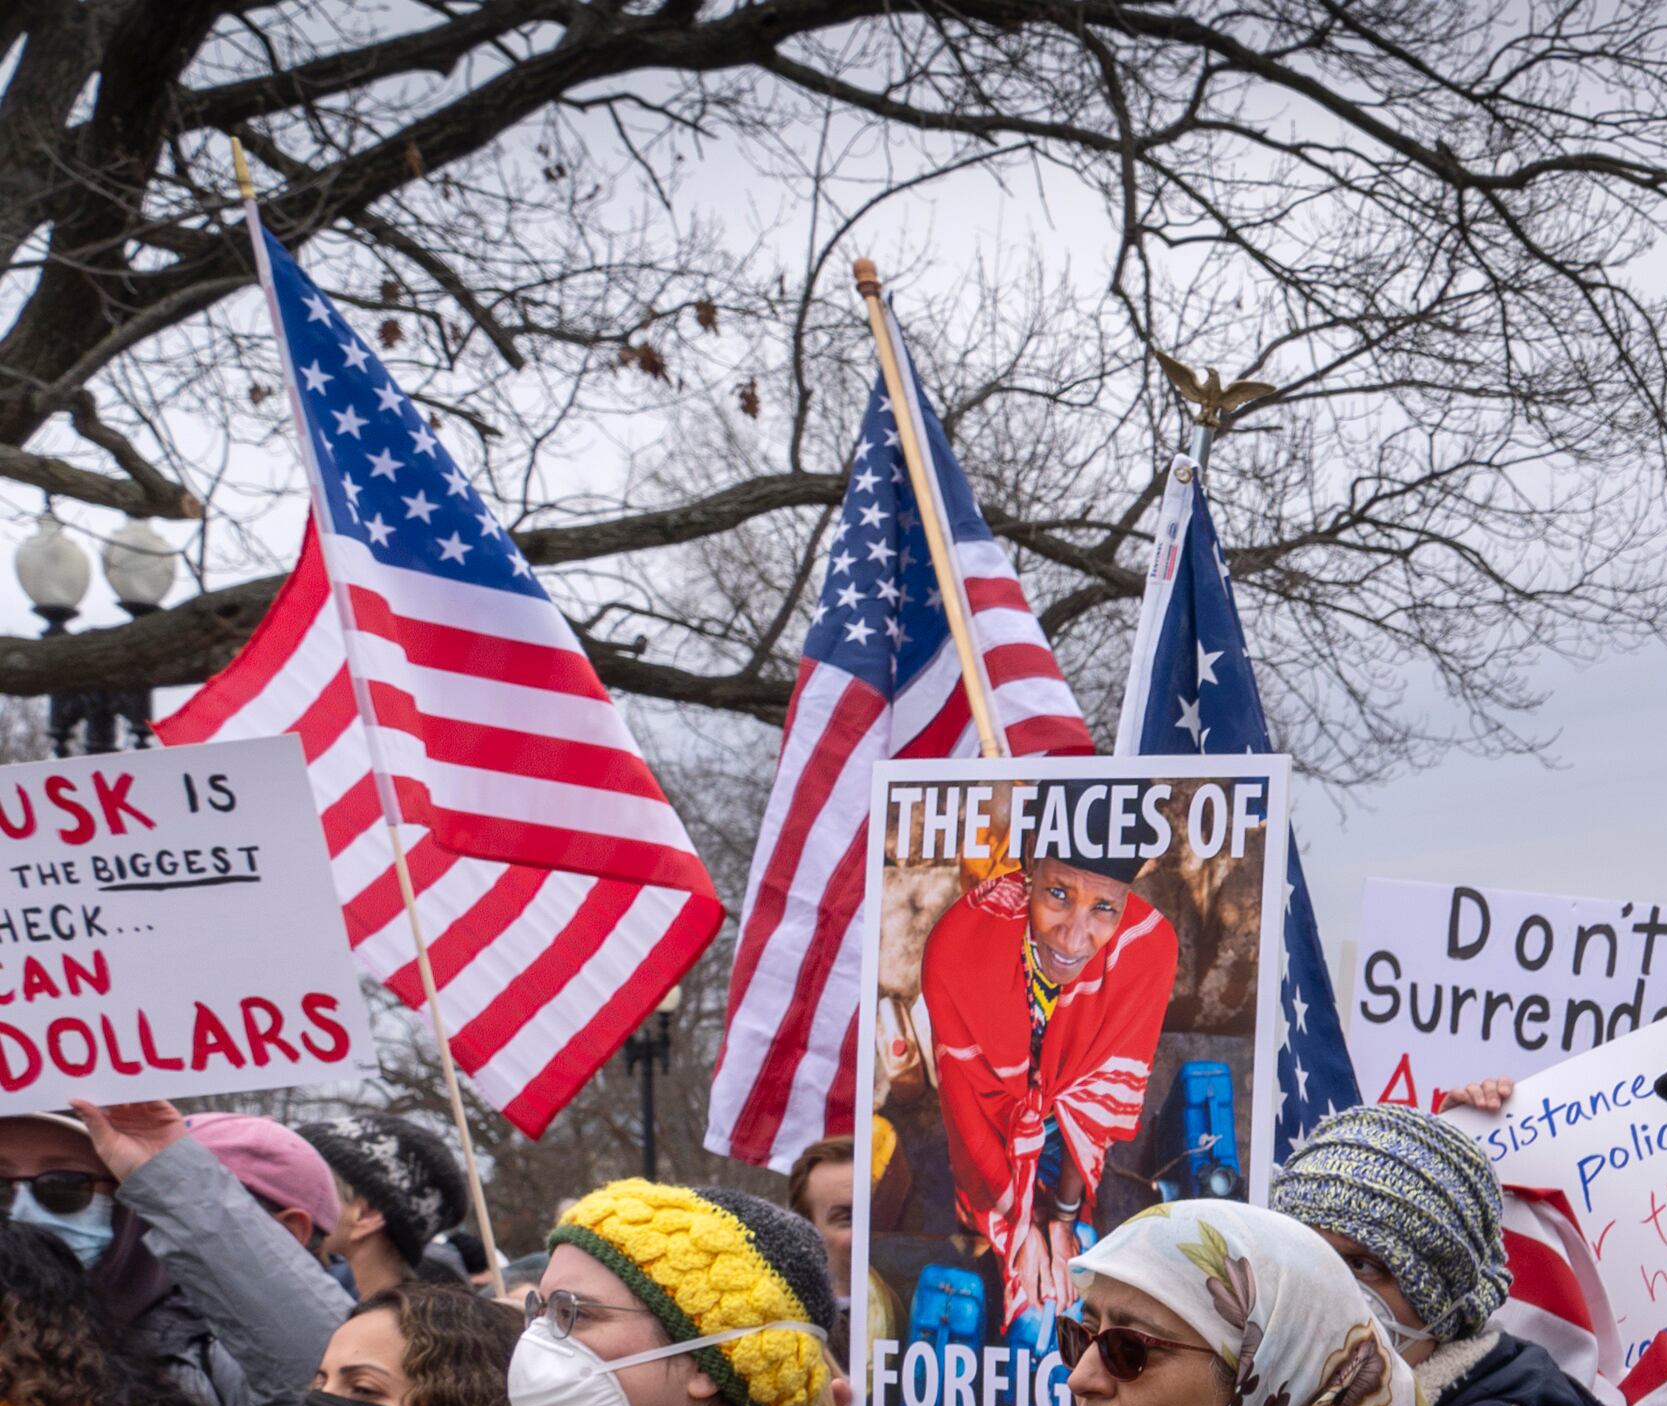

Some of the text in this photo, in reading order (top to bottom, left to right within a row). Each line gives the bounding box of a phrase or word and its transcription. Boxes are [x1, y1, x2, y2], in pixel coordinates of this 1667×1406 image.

[183, 772, 237, 813] IS
[890, 783, 1262, 861] THE FACES OF
[10, 846, 260, 889] THE BIGGEST
[0, 992, 351, 1092] DOLLARS
[1476, 1073, 1657, 1162] sistance
